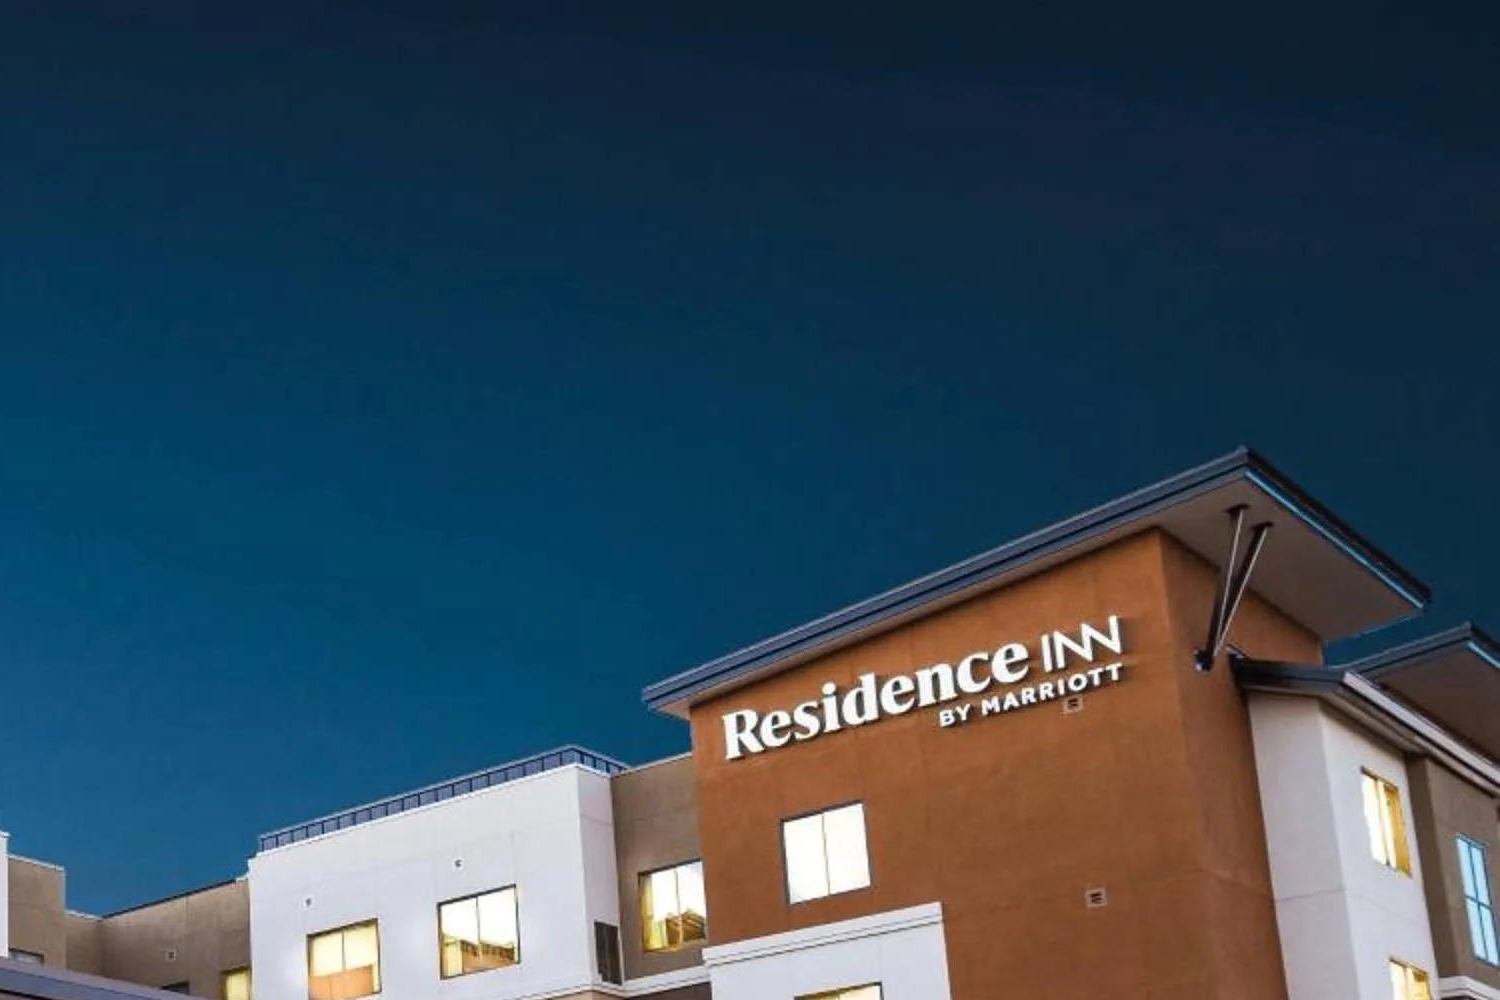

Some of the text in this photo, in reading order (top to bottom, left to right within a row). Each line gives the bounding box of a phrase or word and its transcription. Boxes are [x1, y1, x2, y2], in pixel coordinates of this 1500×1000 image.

[721, 614, 1123, 760] Residence INN
[938, 661, 1124, 728] BY MARRIOTT
